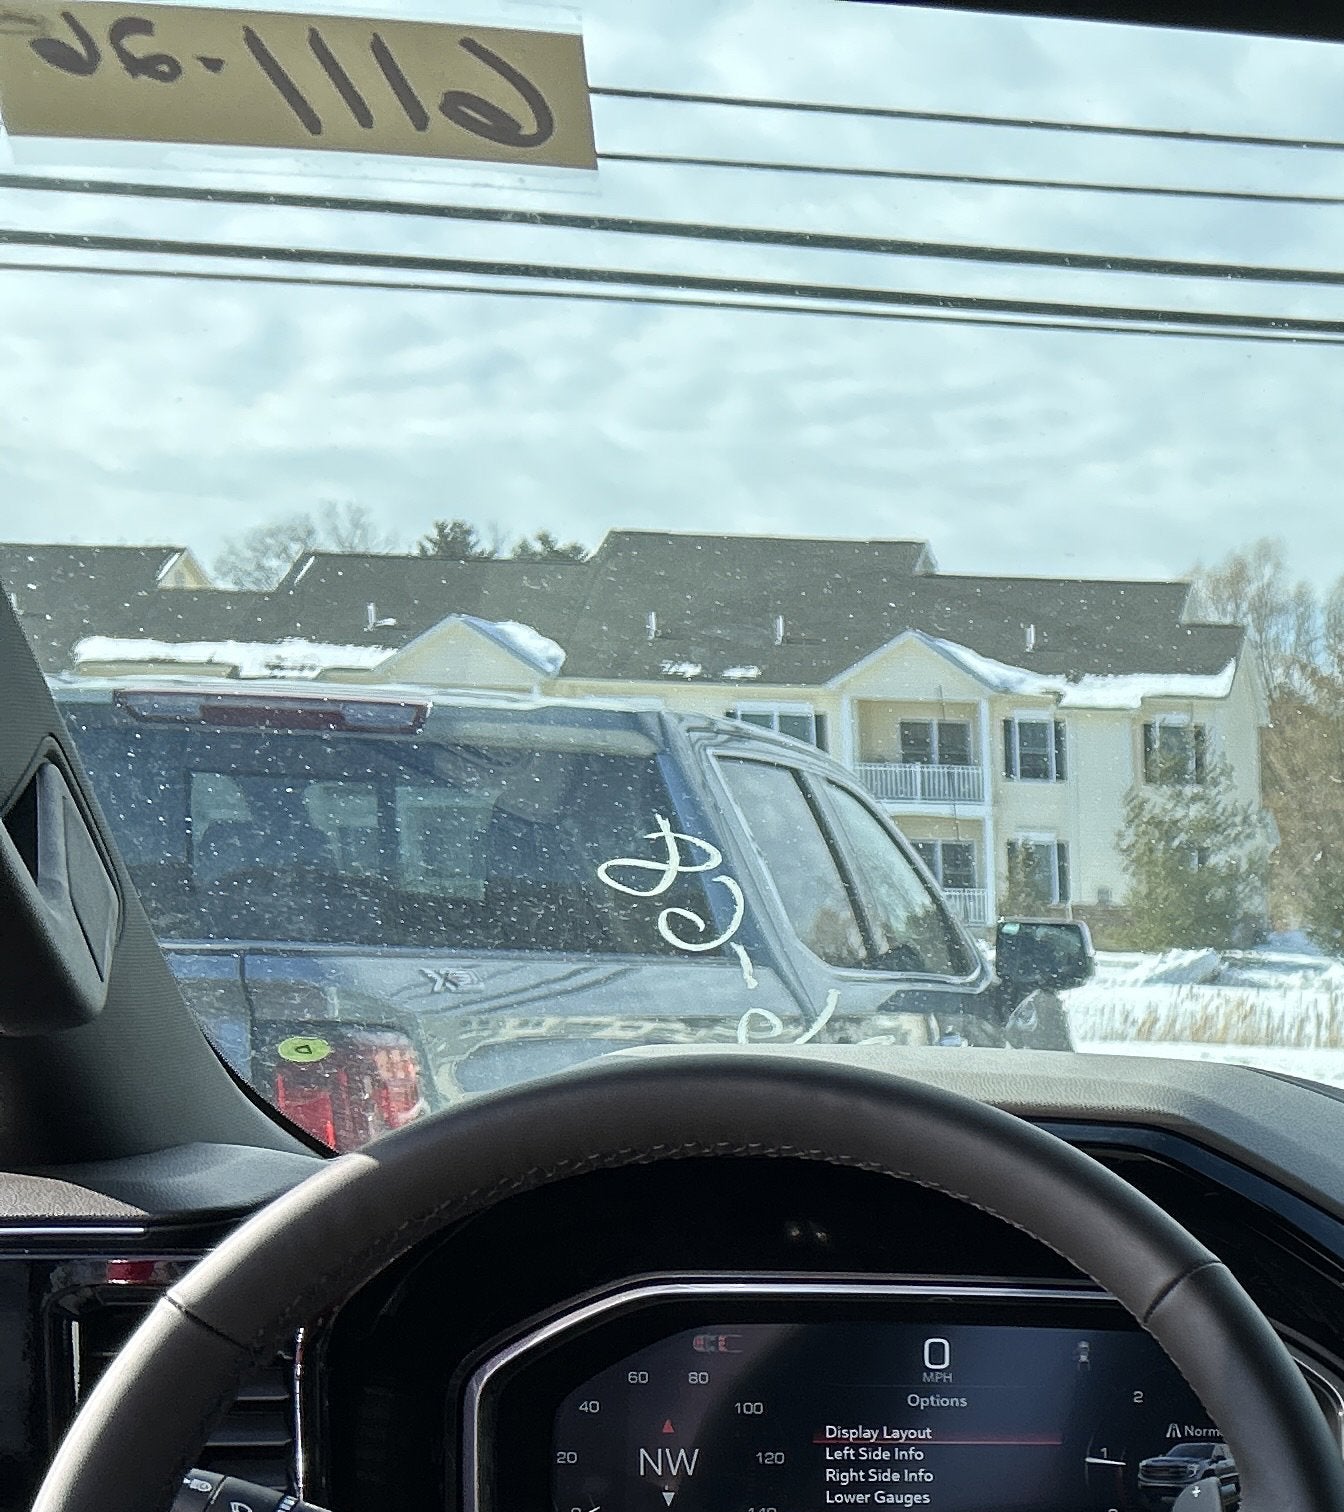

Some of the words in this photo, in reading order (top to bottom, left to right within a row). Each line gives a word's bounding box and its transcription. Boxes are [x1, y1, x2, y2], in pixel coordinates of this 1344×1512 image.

[627, 1371, 649, 1384] 60
[688, 1371, 709, 1385] 80
[922, 1371, 953, 1383] MPH
[906, 1393, 968, 1410] Options
[1133, 1390, 1144, 1403] 2
[578, 1400, 600, 1413] 40
[734, 1402, 764, 1415] 100
[825, 1425, 879, 1444] Display
[883, 1425, 933, 1443] Layout
[1184, 1424, 1224, 1438] Norm
[556, 1451, 578, 1464] 20
[755, 1452, 785, 1465] 120
[825, 1446, 855, 1461] Left
[858, 1447, 891, 1461] Side
[894, 1447, 924, 1461] Info
[638, 1448, 700, 1476] NW
[825, 1469, 865, 1486] Right
[868, 1469, 900, 1483] Side
[904, 1468, 934, 1483] Info
[825, 1490, 870, 1505] Lower
[874, 1490, 931, 1507] Gauges
